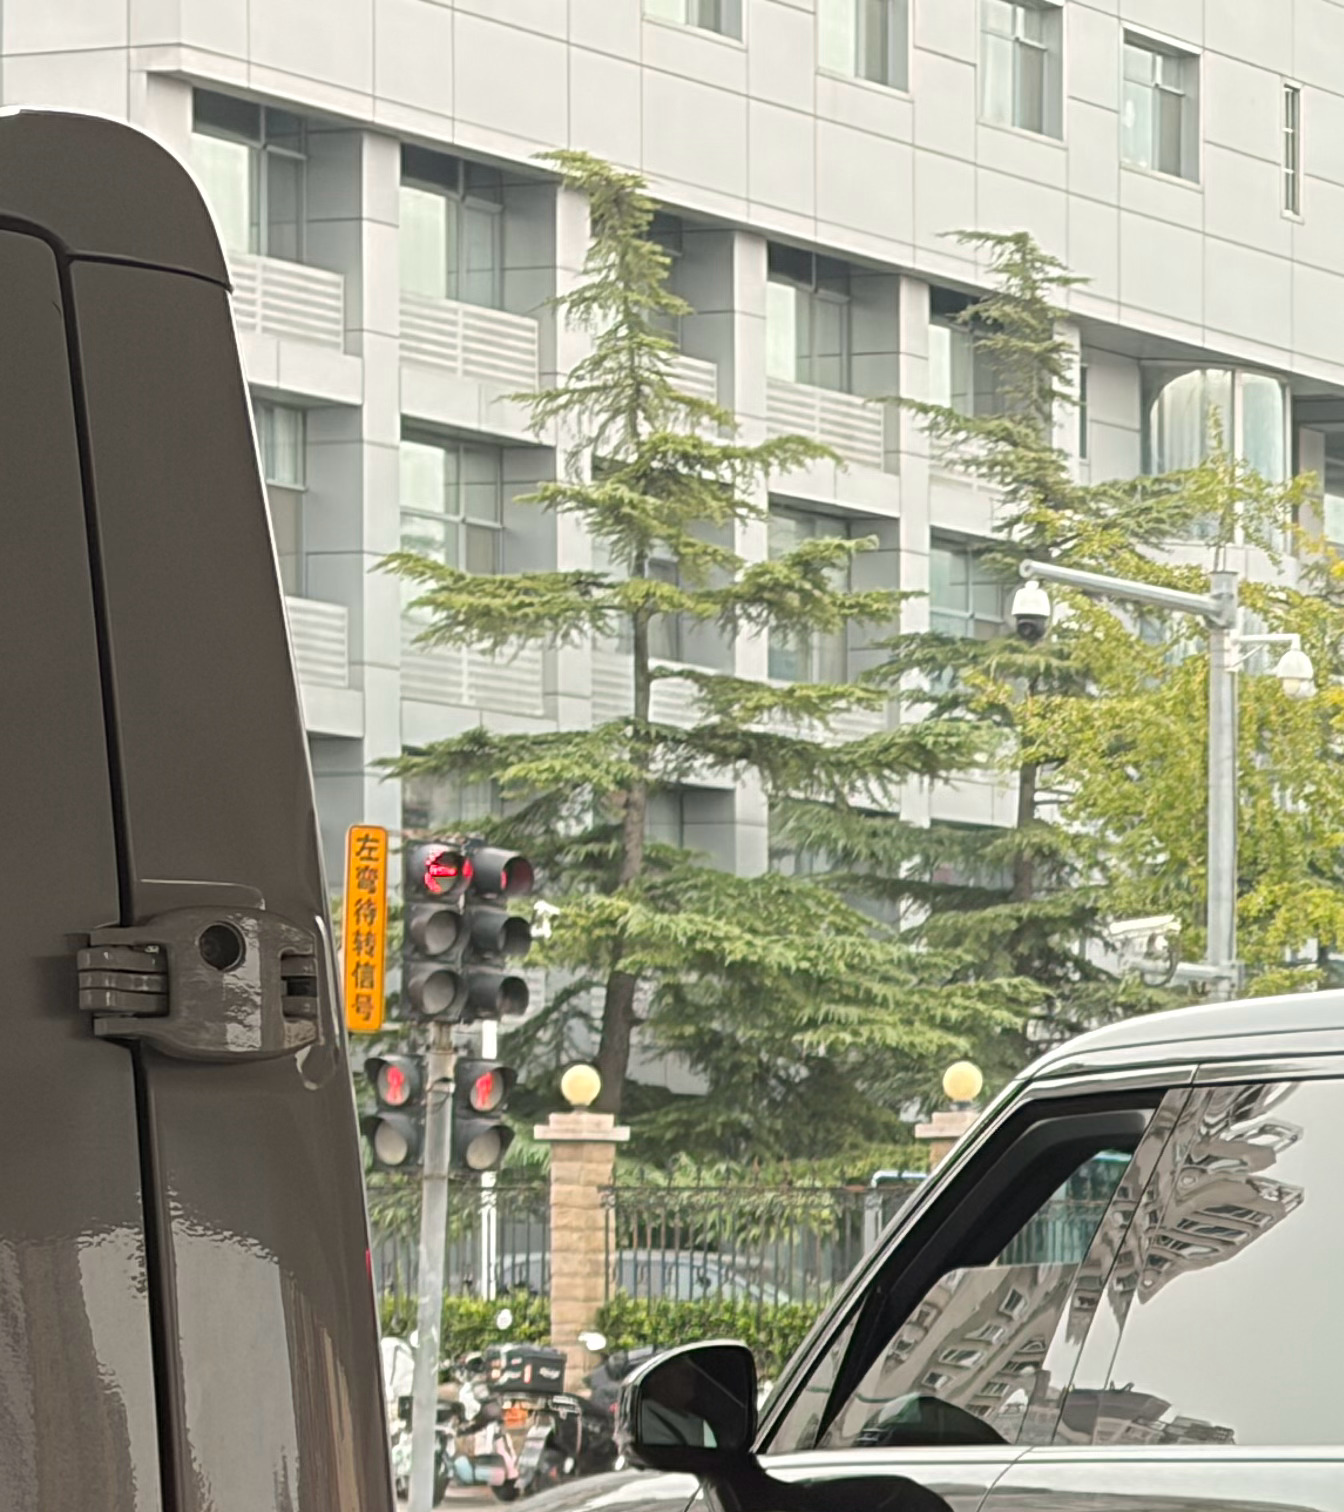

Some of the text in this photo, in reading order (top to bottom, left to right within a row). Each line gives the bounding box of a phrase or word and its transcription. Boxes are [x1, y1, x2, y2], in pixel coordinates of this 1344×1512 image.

[351, 834, 381, 1022] 左弯待转信号
